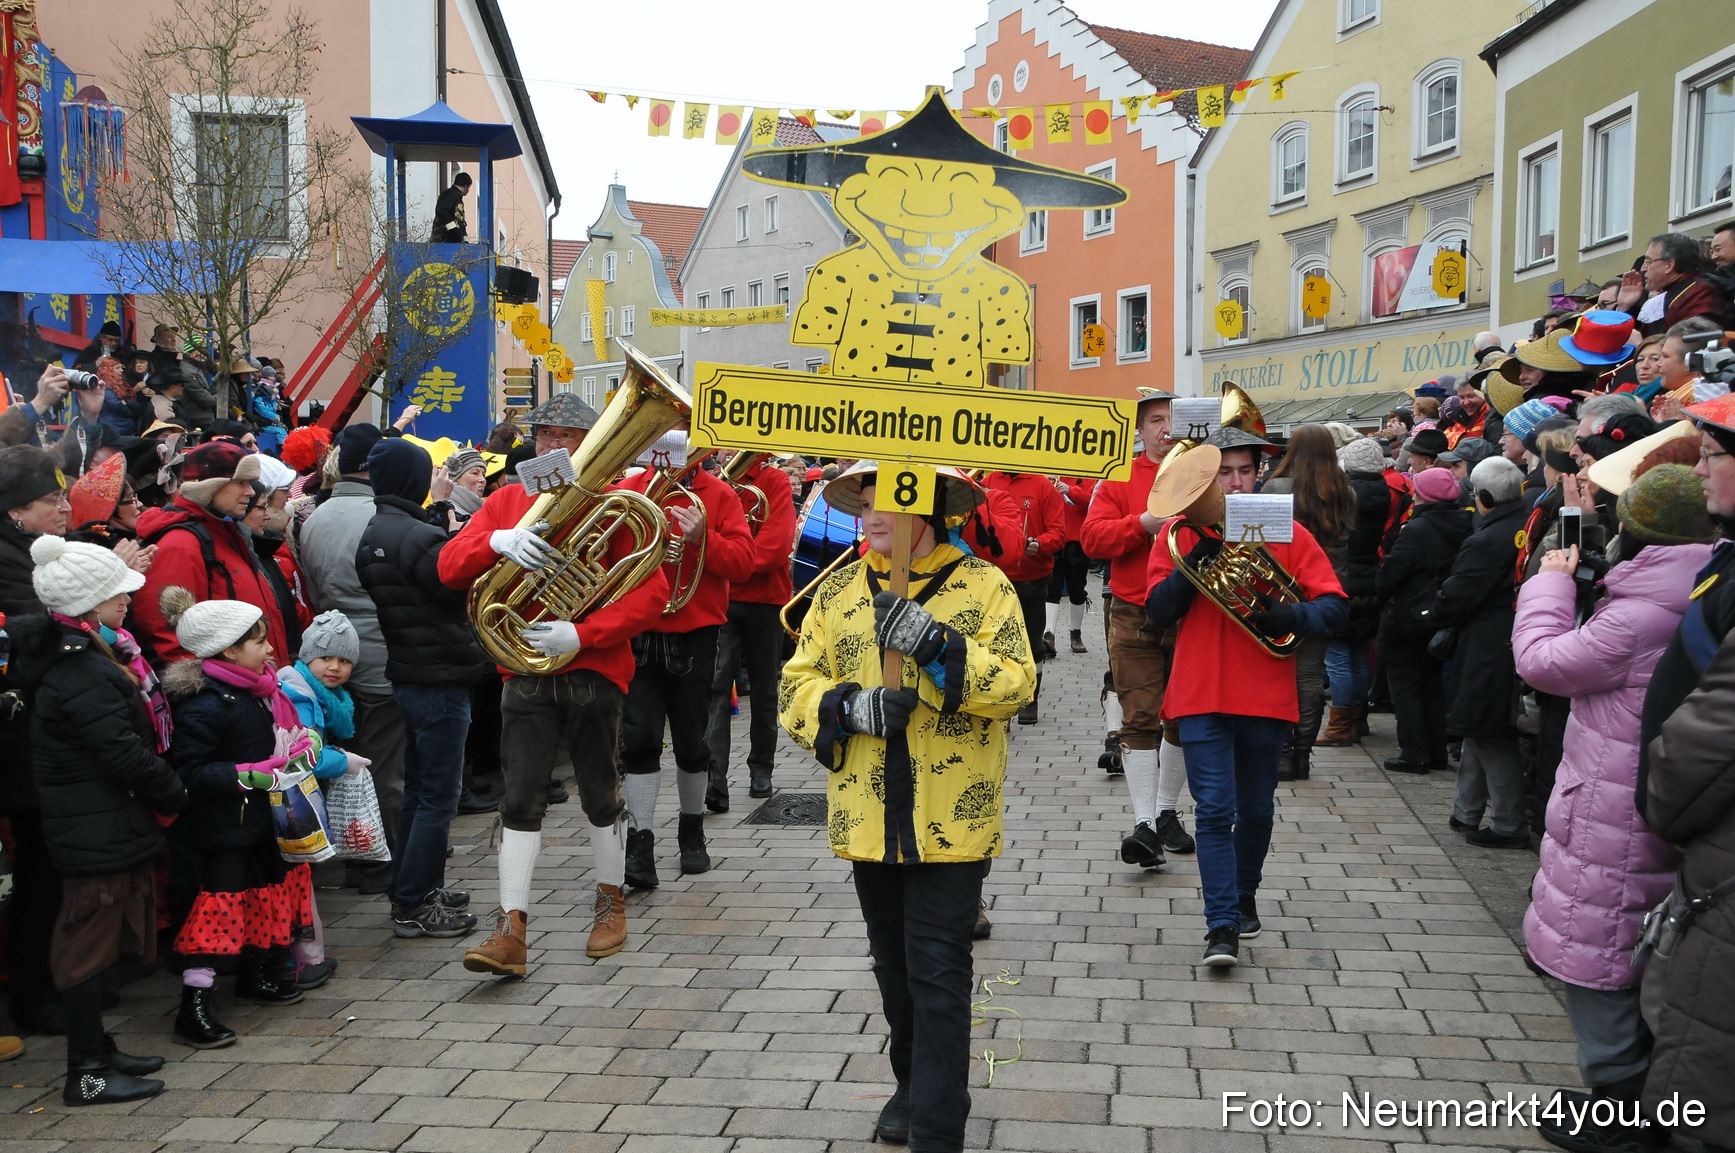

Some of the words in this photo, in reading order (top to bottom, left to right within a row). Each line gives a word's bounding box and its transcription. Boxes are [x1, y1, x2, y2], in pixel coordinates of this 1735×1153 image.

[1299, 346, 1380, 391] STOLL
[709, 389, 942, 442] Bergmusikanten
[952, 409, 1117, 457] Otterzhofen
[894, 471, 919, 507] 8
